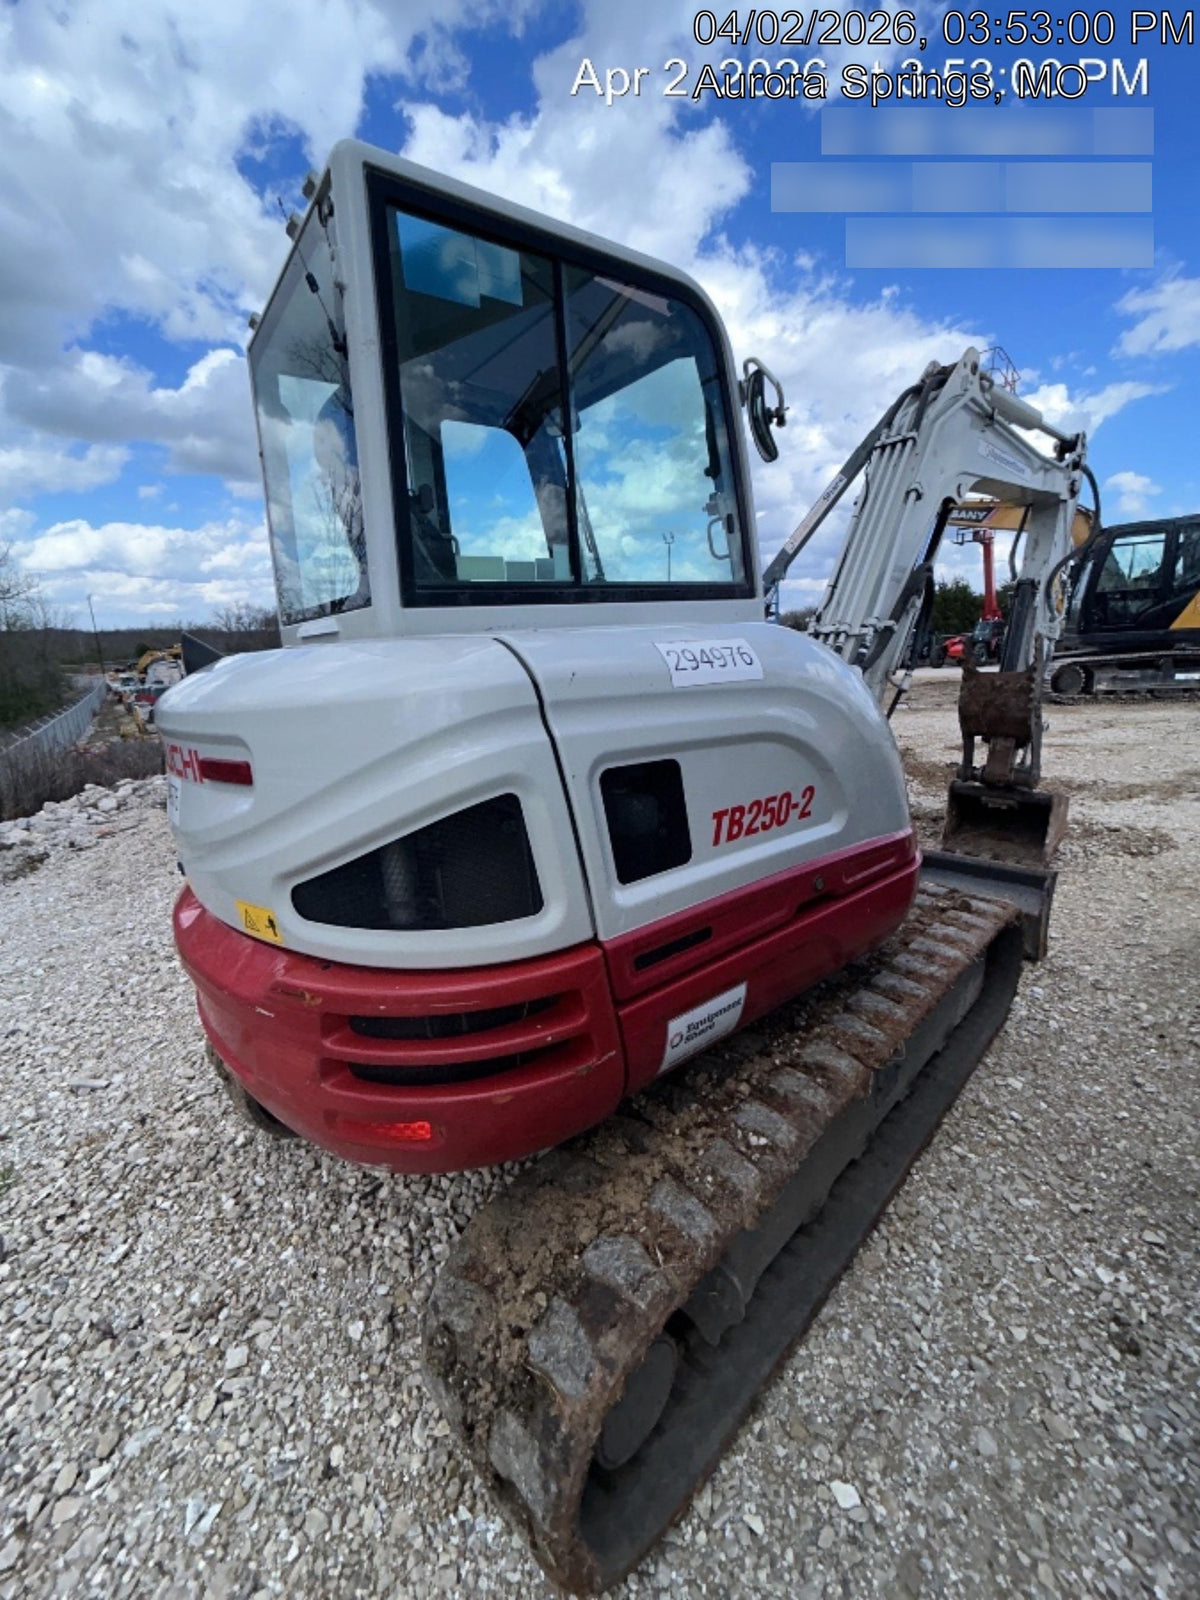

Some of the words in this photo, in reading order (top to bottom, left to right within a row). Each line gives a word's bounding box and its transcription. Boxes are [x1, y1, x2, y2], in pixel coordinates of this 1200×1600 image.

[666, 646, 753, 672] 294976
[712, 785, 815, 847] TB250-2
[686, 997, 742, 1034] Equipment
